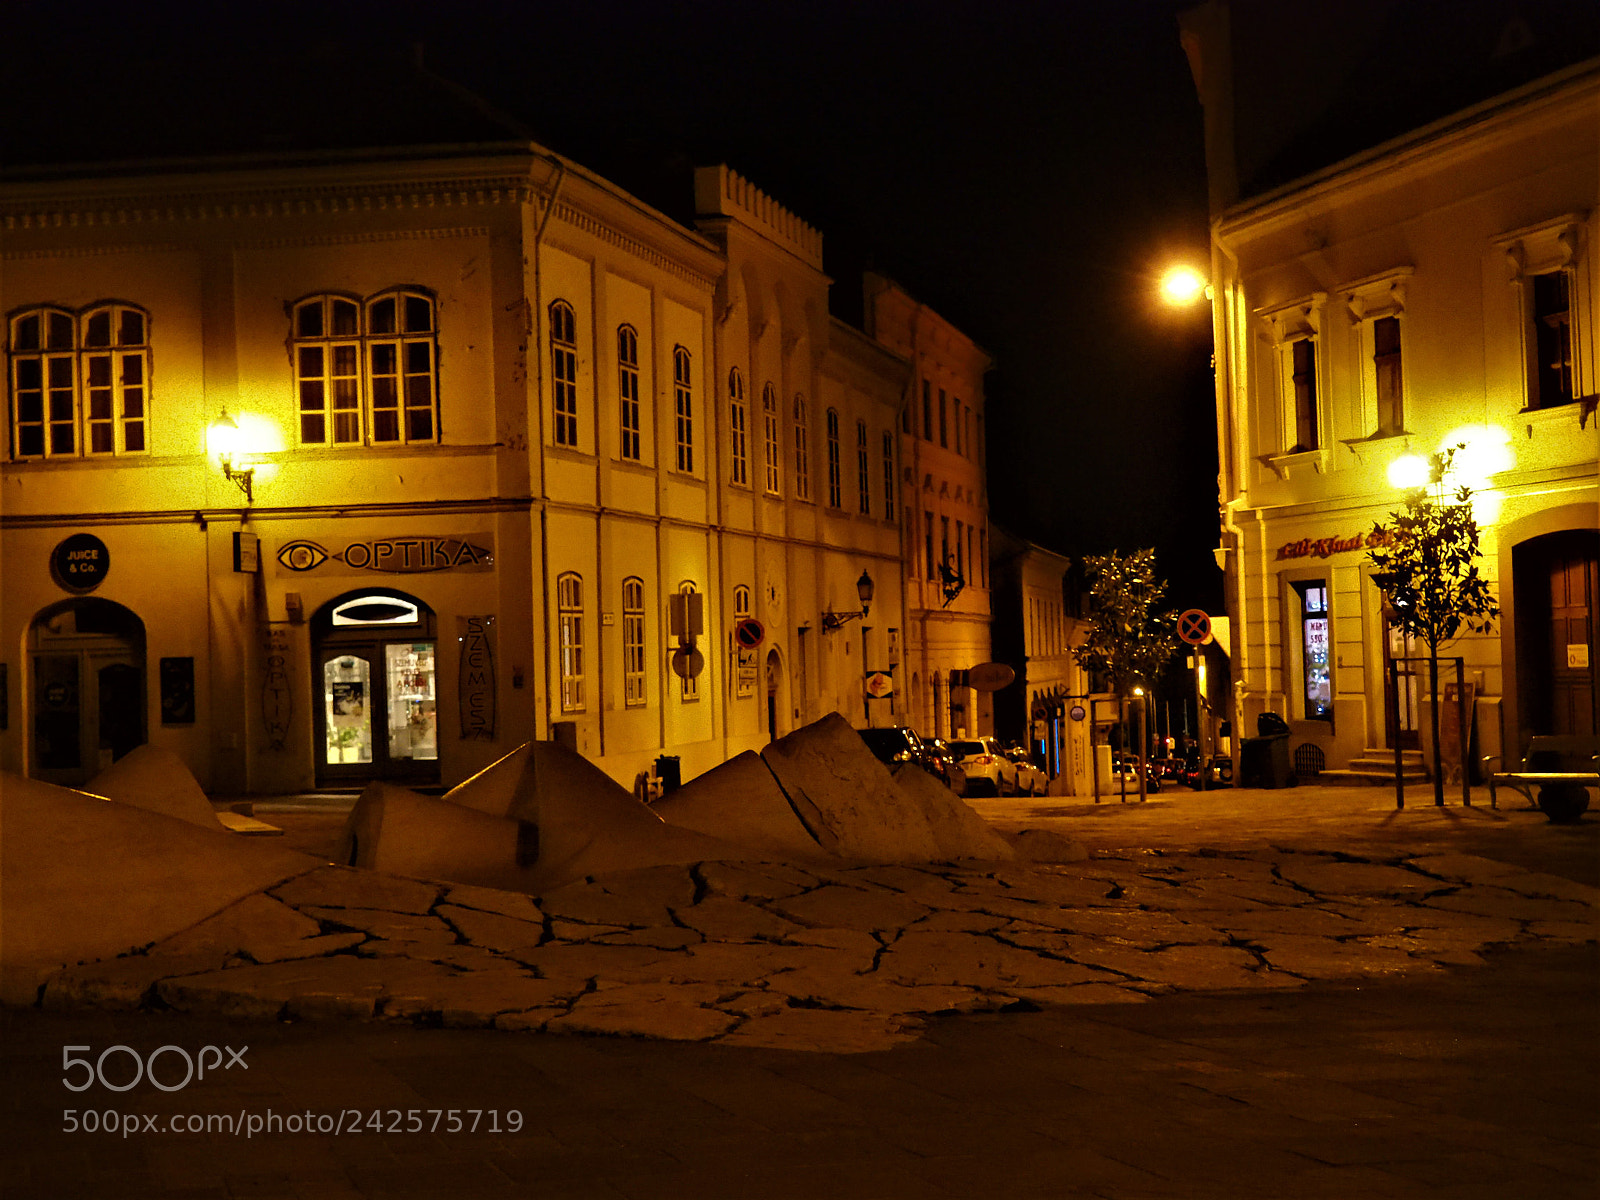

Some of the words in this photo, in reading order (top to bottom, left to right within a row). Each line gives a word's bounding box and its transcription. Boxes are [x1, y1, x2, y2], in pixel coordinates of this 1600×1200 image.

[66, 549, 99, 561] JUICE
[344, 541, 480, 568] OPTIKA
[69, 563, 78, 574] &
[80, 562, 98, 573] Co.
